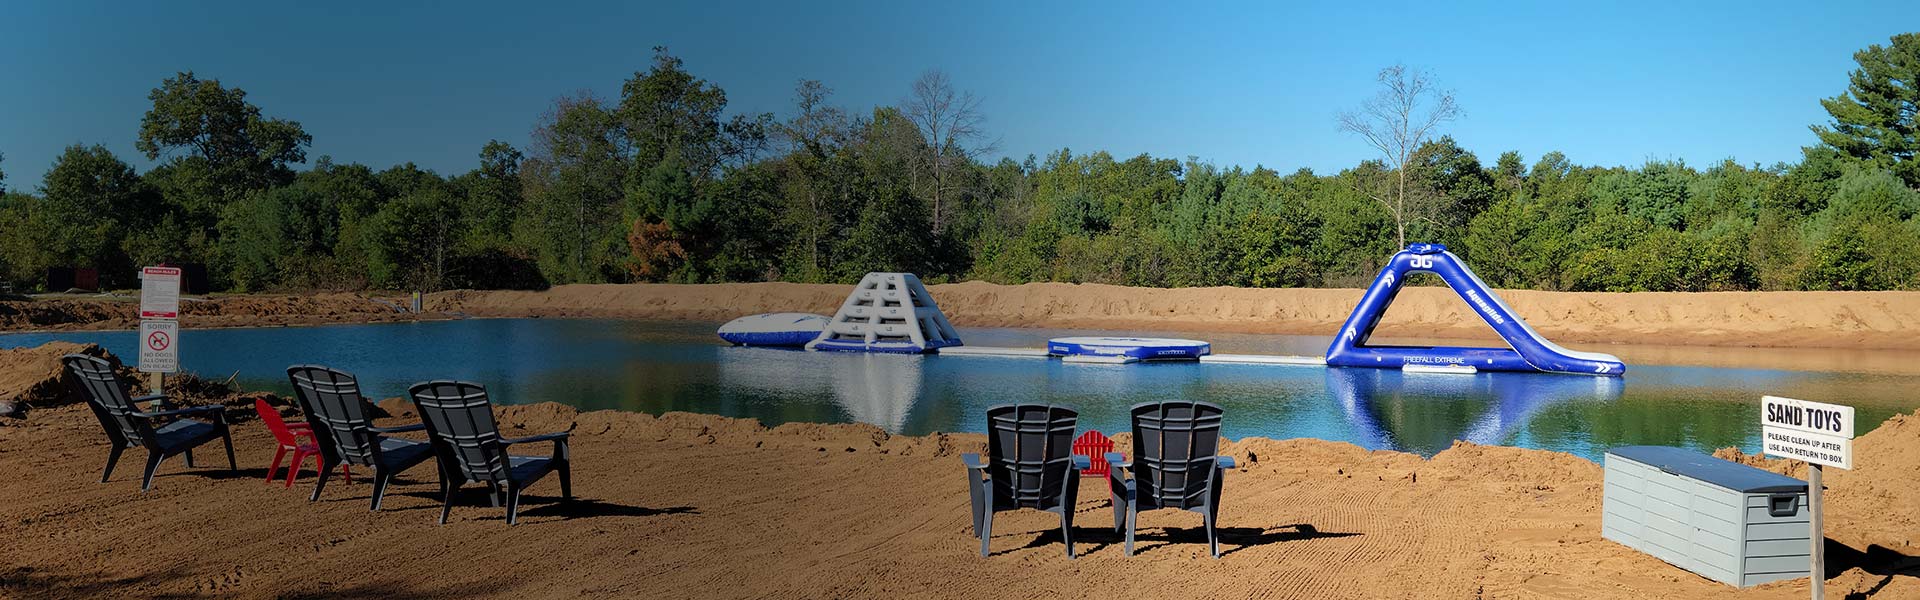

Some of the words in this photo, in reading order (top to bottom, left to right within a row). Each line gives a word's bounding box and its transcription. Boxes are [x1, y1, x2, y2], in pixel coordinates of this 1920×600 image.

[1465, 288, 1504, 324] Aquaglide
[1768, 402, 1802, 426] SAND
[1806, 408, 1842, 432] TOYS
[1768, 432, 1790, 442] PLEASE
[1791, 436, 1810, 446] CLEAN
[1822, 442, 1841, 451] AFTER
[1795, 448, 1819, 459] RETURN
[1829, 455, 1842, 463] BOX
